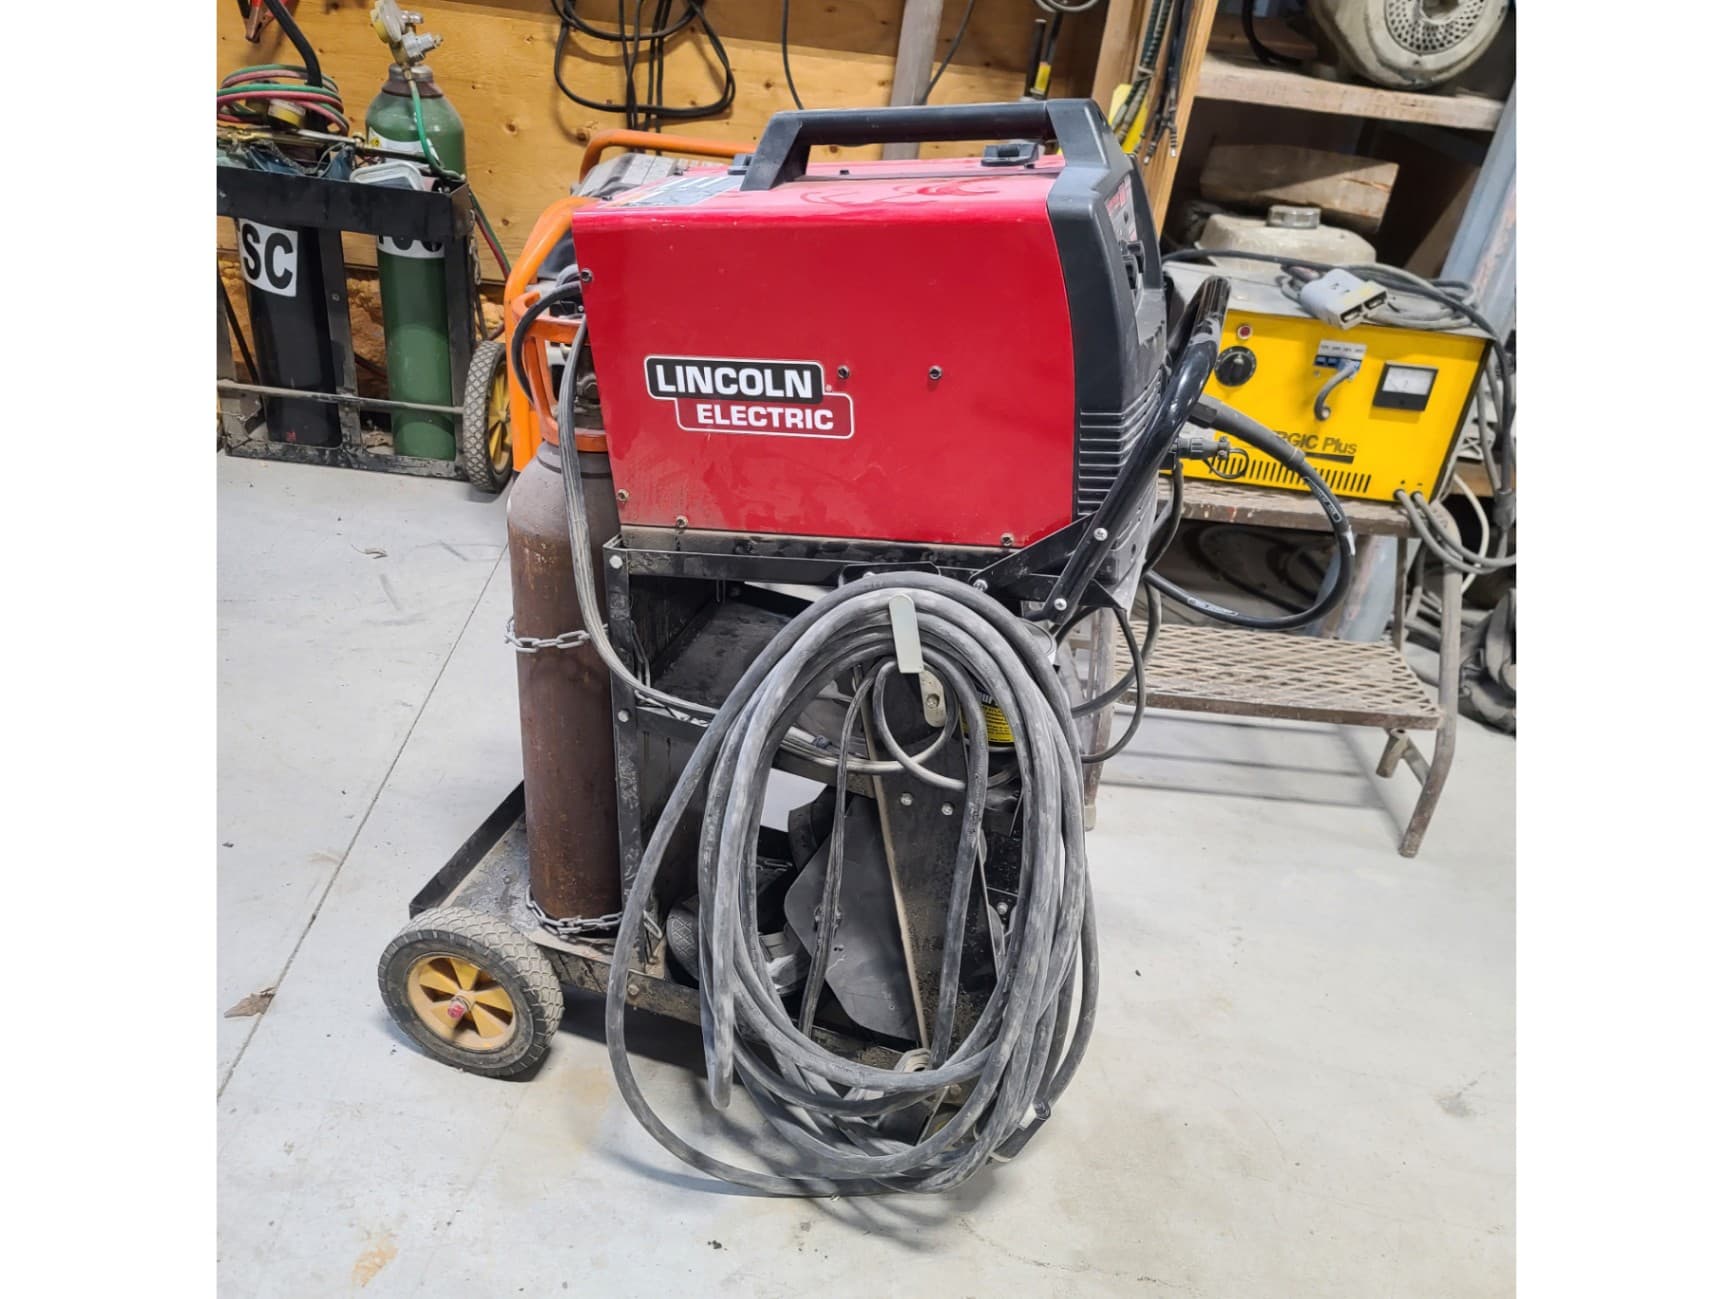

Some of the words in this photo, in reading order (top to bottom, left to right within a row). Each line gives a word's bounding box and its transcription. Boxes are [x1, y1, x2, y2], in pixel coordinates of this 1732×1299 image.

[656, 364, 813, 399] LINCOLN
[696, 403, 834, 431] ELECTRIC
[1322, 436, 1358, 455] Plus
